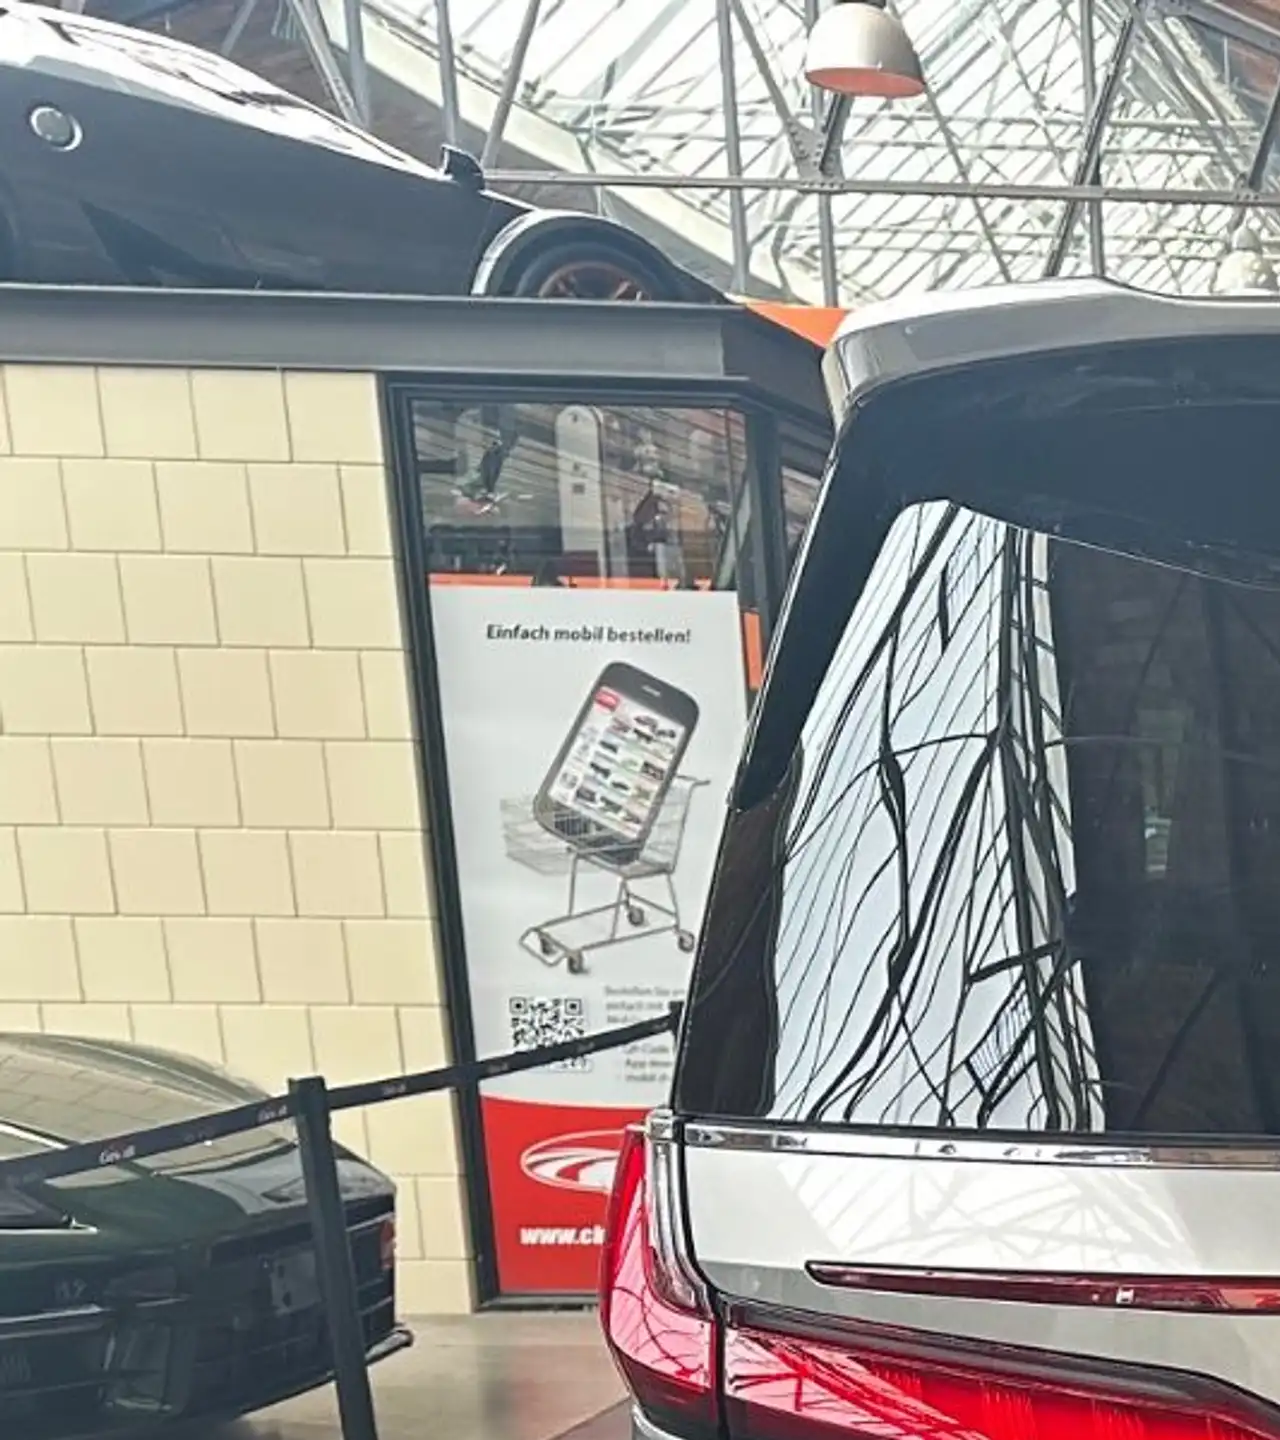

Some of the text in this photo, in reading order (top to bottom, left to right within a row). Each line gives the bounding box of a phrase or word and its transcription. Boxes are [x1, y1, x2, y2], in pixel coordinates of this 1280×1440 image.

[486, 623, 691, 644] Einfach mobil bestellen!
